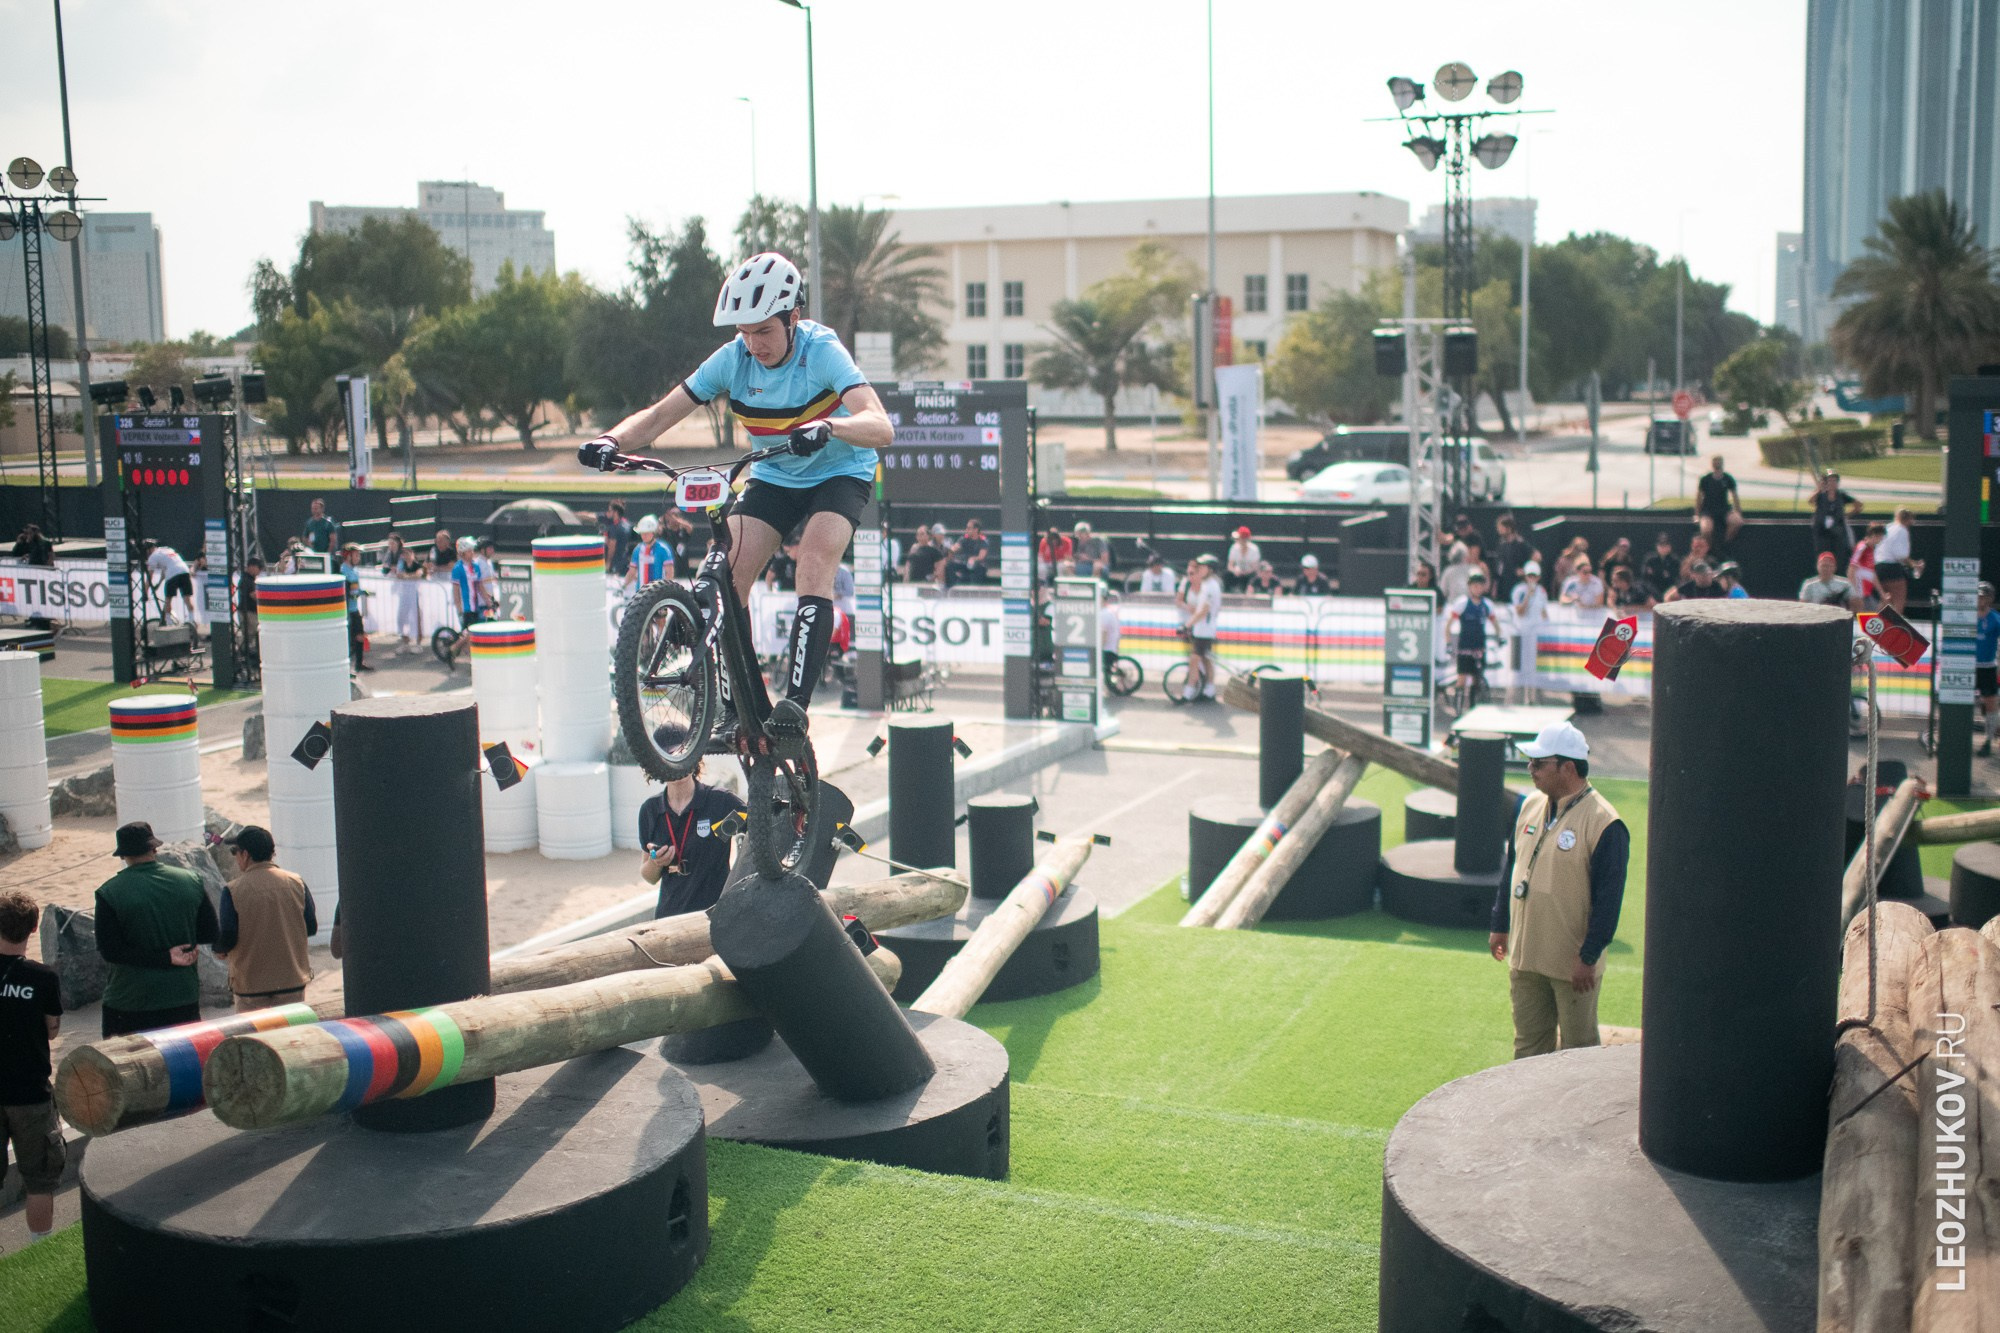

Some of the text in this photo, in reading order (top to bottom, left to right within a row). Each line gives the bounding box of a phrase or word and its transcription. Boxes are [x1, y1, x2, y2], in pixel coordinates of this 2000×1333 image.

[914, 395, 956, 408] FINISH
[975, 411, 999, 425] 0:42
[893, 430, 964, 441] OKOTA Kotaro
[188, 453, 200, 466] 20
[885, 454, 998, 470] 10 10 10 10 10 50
[687, 485, 718, 499] 308
[858, 533, 876, 541] UCI
[1951, 562, 1976, 573] UCI
[17, 578, 110, 608] TISSO
[502, 582, 529, 594] START
[509, 594, 526, 621] 2
[1066, 614, 1086, 644] 2
[1388, 616, 1429, 629] START
[860, 626, 877, 634] UCI
[891, 616, 1000, 647] SSOT
[1007, 631, 1026, 640] UCI
[1397, 630, 1419, 661] 3
[792, 621, 810, 688] CLEAN
[720, 647, 731, 701] CLEA
[1948, 676, 1972, 687] UCI
[0, 983, 34, 1000] ING
